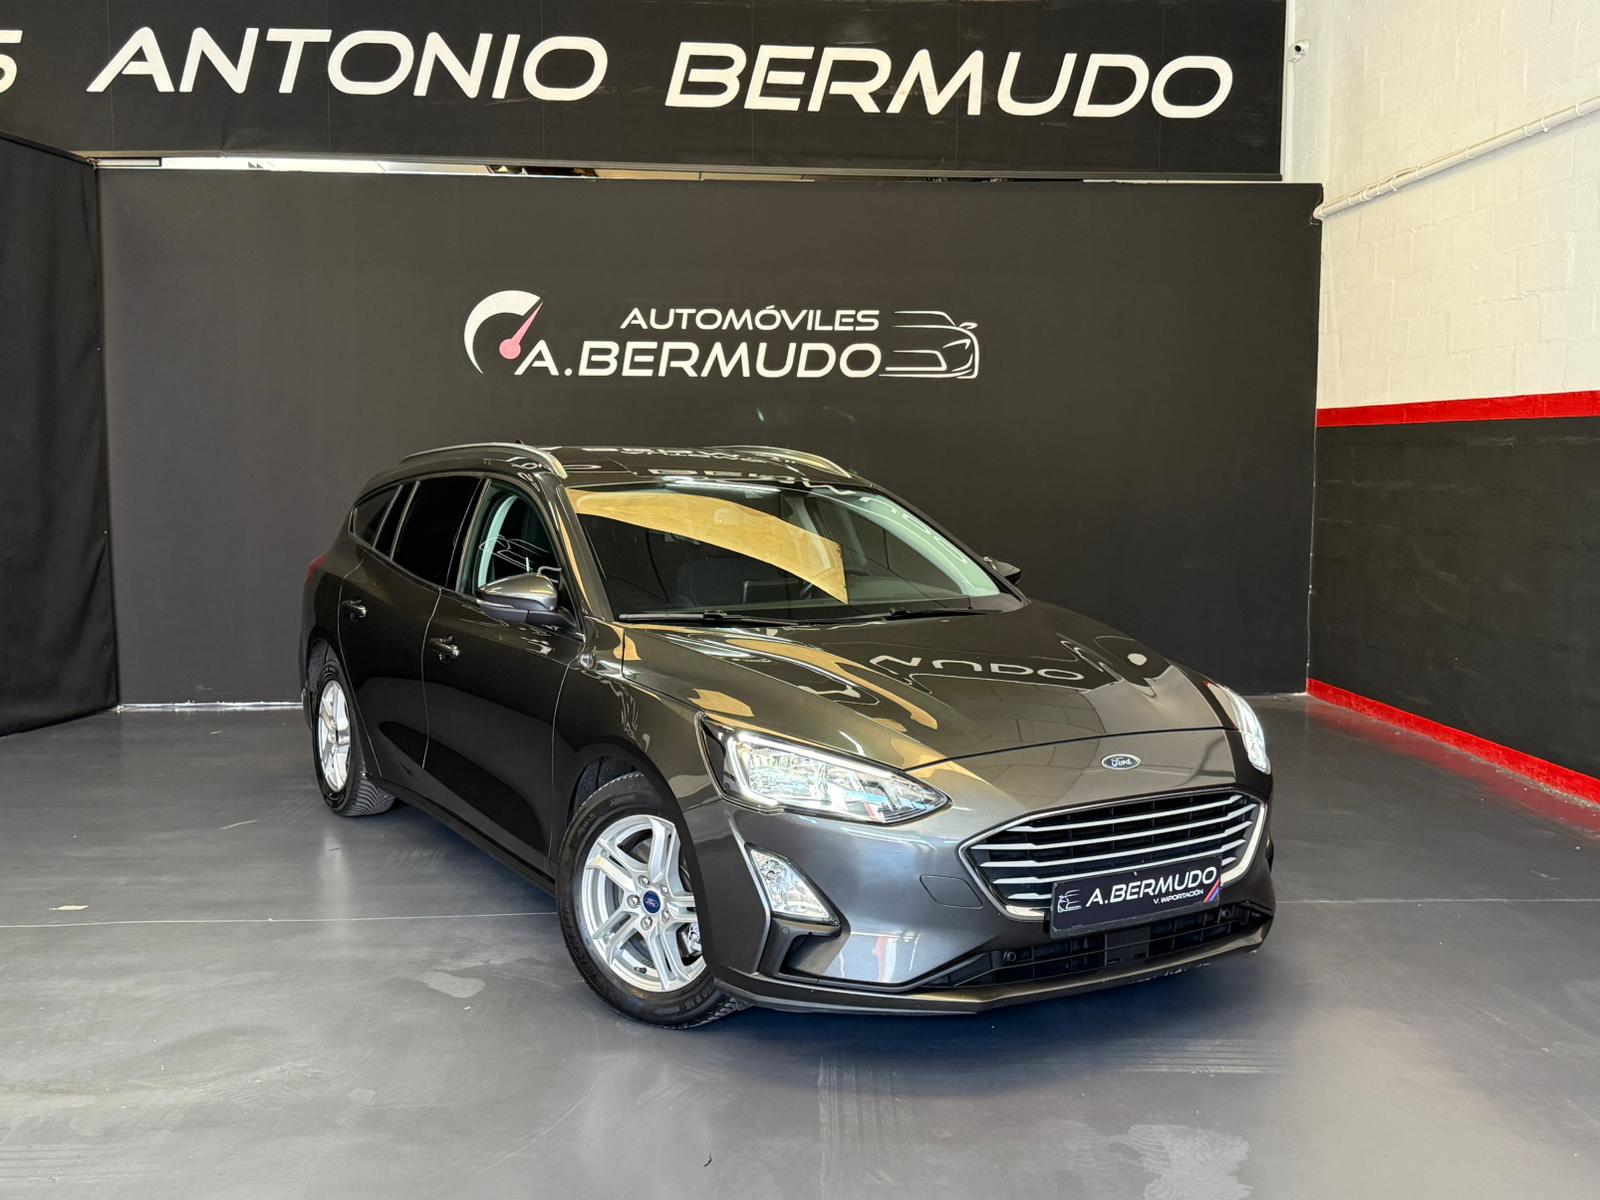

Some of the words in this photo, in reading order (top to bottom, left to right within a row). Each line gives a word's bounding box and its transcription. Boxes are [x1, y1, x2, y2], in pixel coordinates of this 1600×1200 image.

[87, 27, 608, 102] ANTONIO
[665, 42, 1234, 119] BERMUDO
[620, 305, 880, 331] AUTOMÓVILES
[513, 340, 882, 378] A.BERMUDO
[1086, 867, 1217, 907] A.BERMUDO
